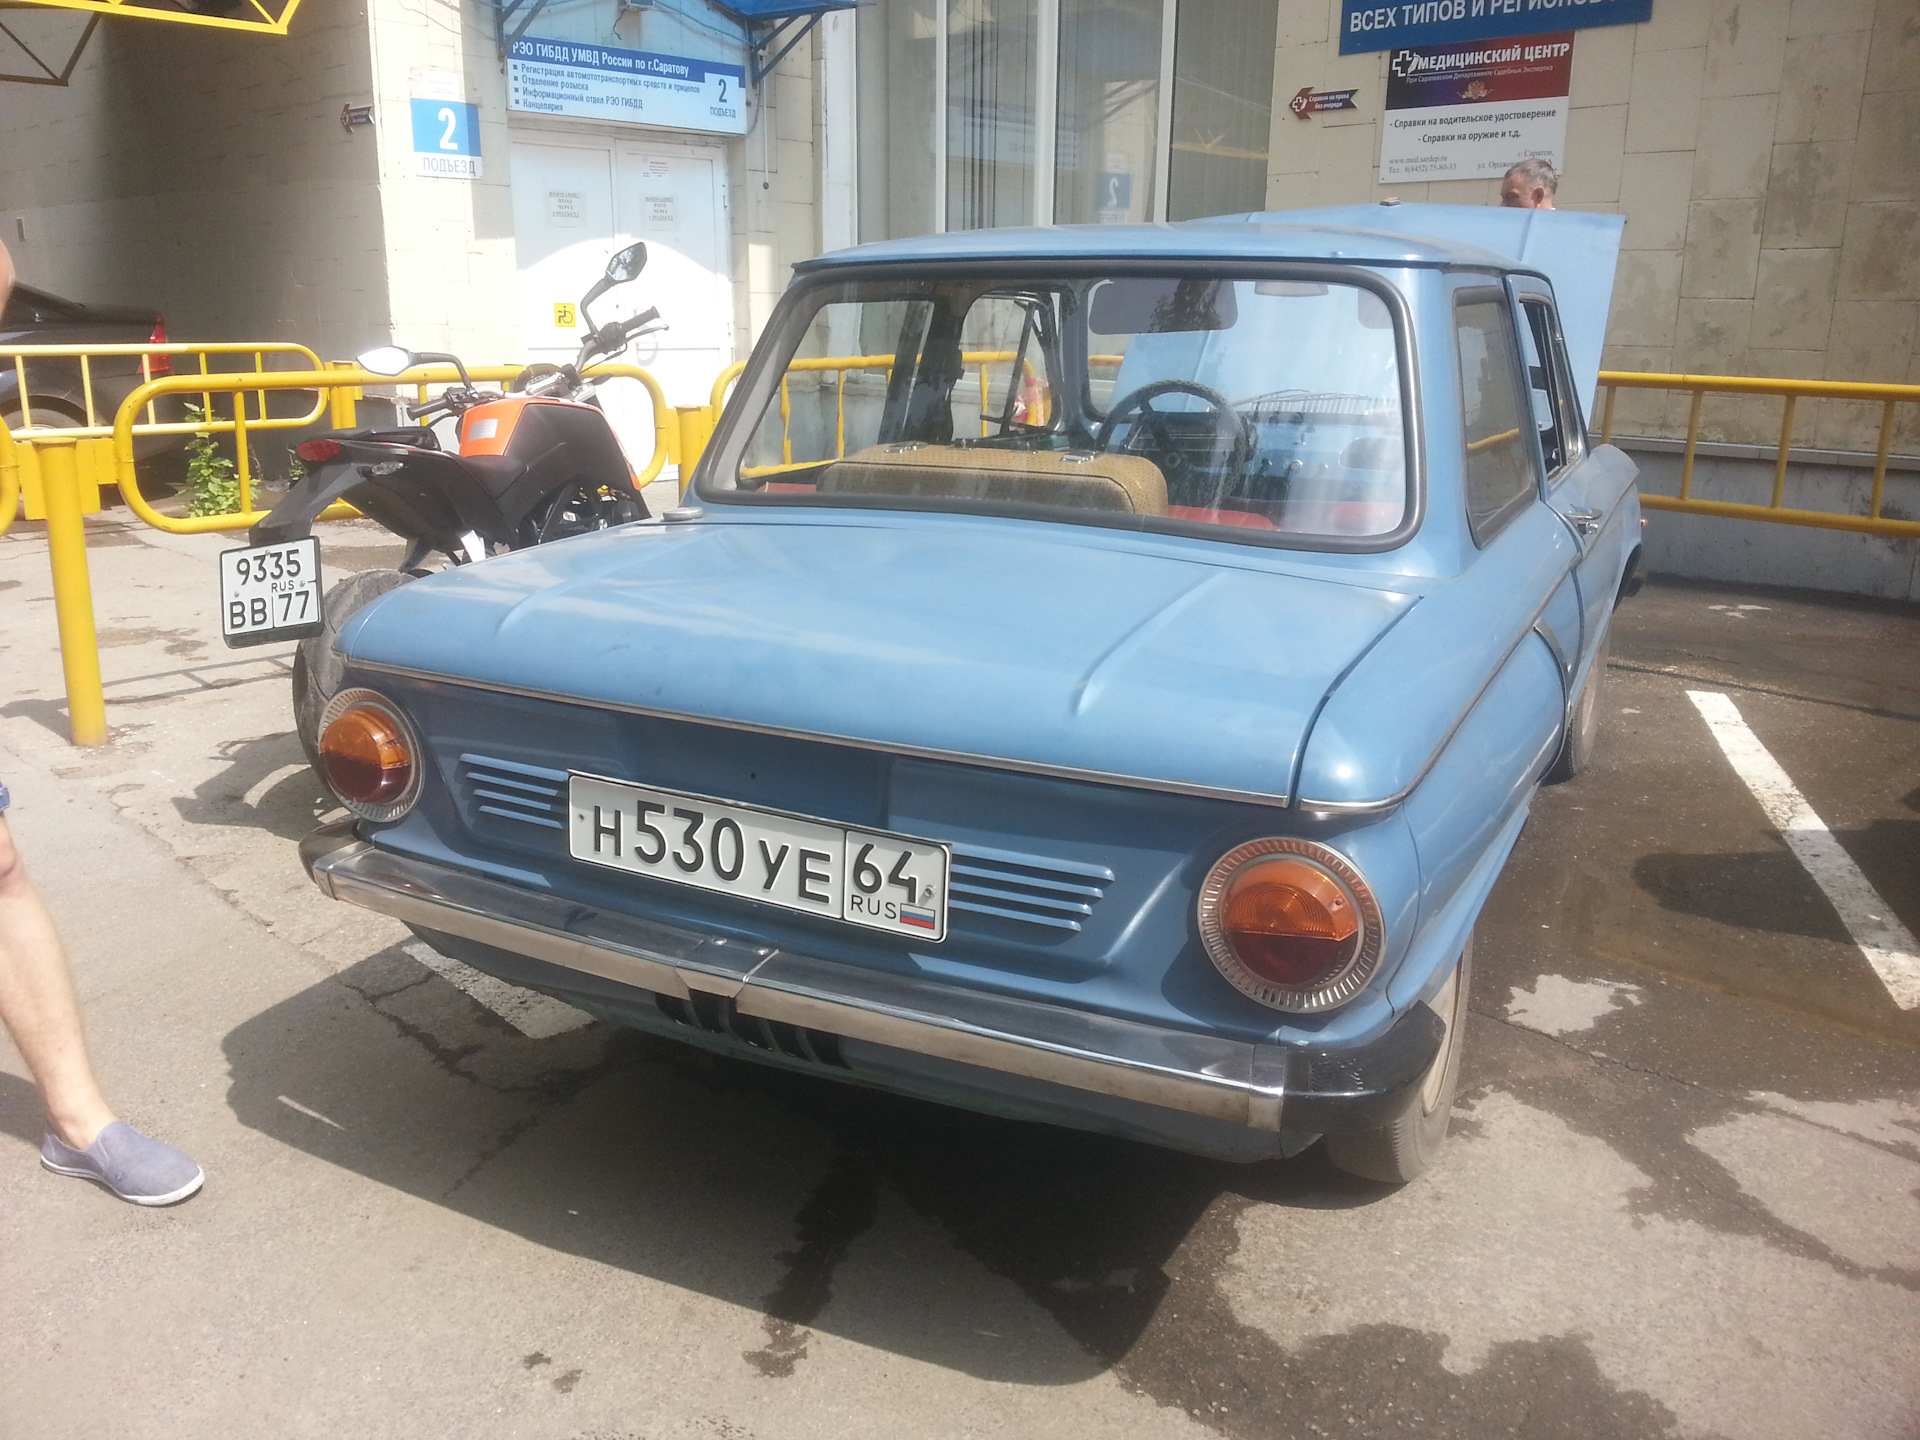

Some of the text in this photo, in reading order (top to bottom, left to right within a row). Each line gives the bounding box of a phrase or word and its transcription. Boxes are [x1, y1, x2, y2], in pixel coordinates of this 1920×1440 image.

[1351, 6, 1398, 33] ВСЕХ
[1402, 0, 1466, 26] ТИПОВ
[1471, 0, 1484, 18] И
[536, 43, 570, 62] ГИБДД
[571, 47, 600, 66] УМВД
[602, 52, 633, 68] России
[635, 59, 645, 69] по
[647, 58, 690, 78] г.Саратову
[1417, 42, 1571, 71] МЕДИЦИНСКИЙ ЦЕНТР
[521, 63, 565, 77] Регистрация
[566, 71, 642, 86] автомототранспортных
[643, 81, 667, 90] средств
[673, 83, 700, 94] прицепов
[522, 75, 589, 91] Отделение розыска
[718, 78, 728, 103] 2
[1406, 77, 1418, 85] При
[522, 87, 643, 110] Информационный отдел РЭО ГИБДД
[523, 99, 564, 113] Канцелярия
[709, 106, 737, 119] ПОДЪЕЗД
[1394, 119, 1427, 130] Справки
[1428, 118, 1437, 126] на
[1439, 114, 1494, 126] водительское
[1494, 109, 1557, 123] удостоверение
[438, 107, 458, 151] 2
[1422, 134, 1456, 144] Справки
[1468, 131, 1499, 141] оружие
[1501, 130, 1506, 138] и
[1508, 130, 1521, 138] т.д.
[423, 157, 477, 177] ПОДЪЕЗД
[236, 548, 302, 586] 9335
[271, 580, 295, 593] RUS
[229, 590, 310, 630] ВВ 77
[852, 843, 918, 904] 64
[850, 894, 897, 920] RUS
